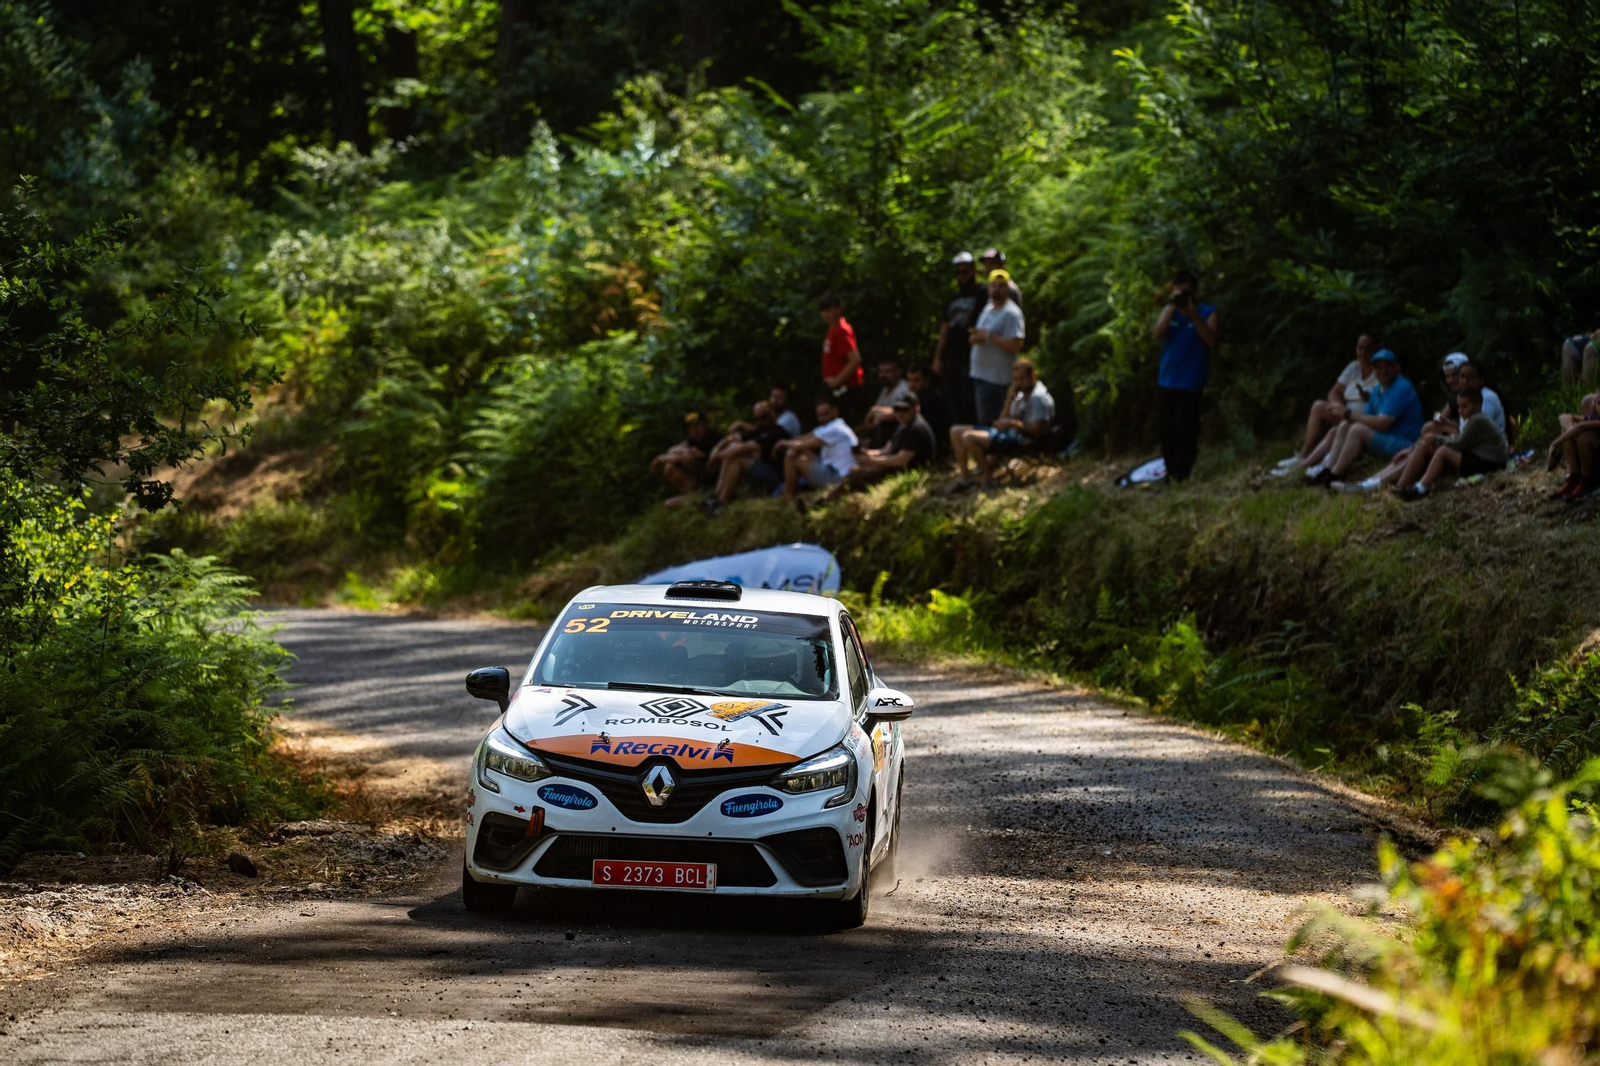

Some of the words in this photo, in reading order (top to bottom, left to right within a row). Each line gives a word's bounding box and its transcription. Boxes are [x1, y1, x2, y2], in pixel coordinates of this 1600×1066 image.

[609, 610, 759, 624] DRIVELAND
[682, 619, 758, 629] MOTORSPORT
[563, 617, 611, 634] 52
[874, 697, 904, 707] ARC
[604, 717, 732, 732] ROMBOSOL
[613, 741, 712, 760] Recalvi
[543, 787, 593, 808] Fuengirola
[724, 799, 779, 815] Fuengirola
[602, 865, 612, 881] S
[623, 866, 664, 883] 2373
[675, 868, 705, 885] BCL
